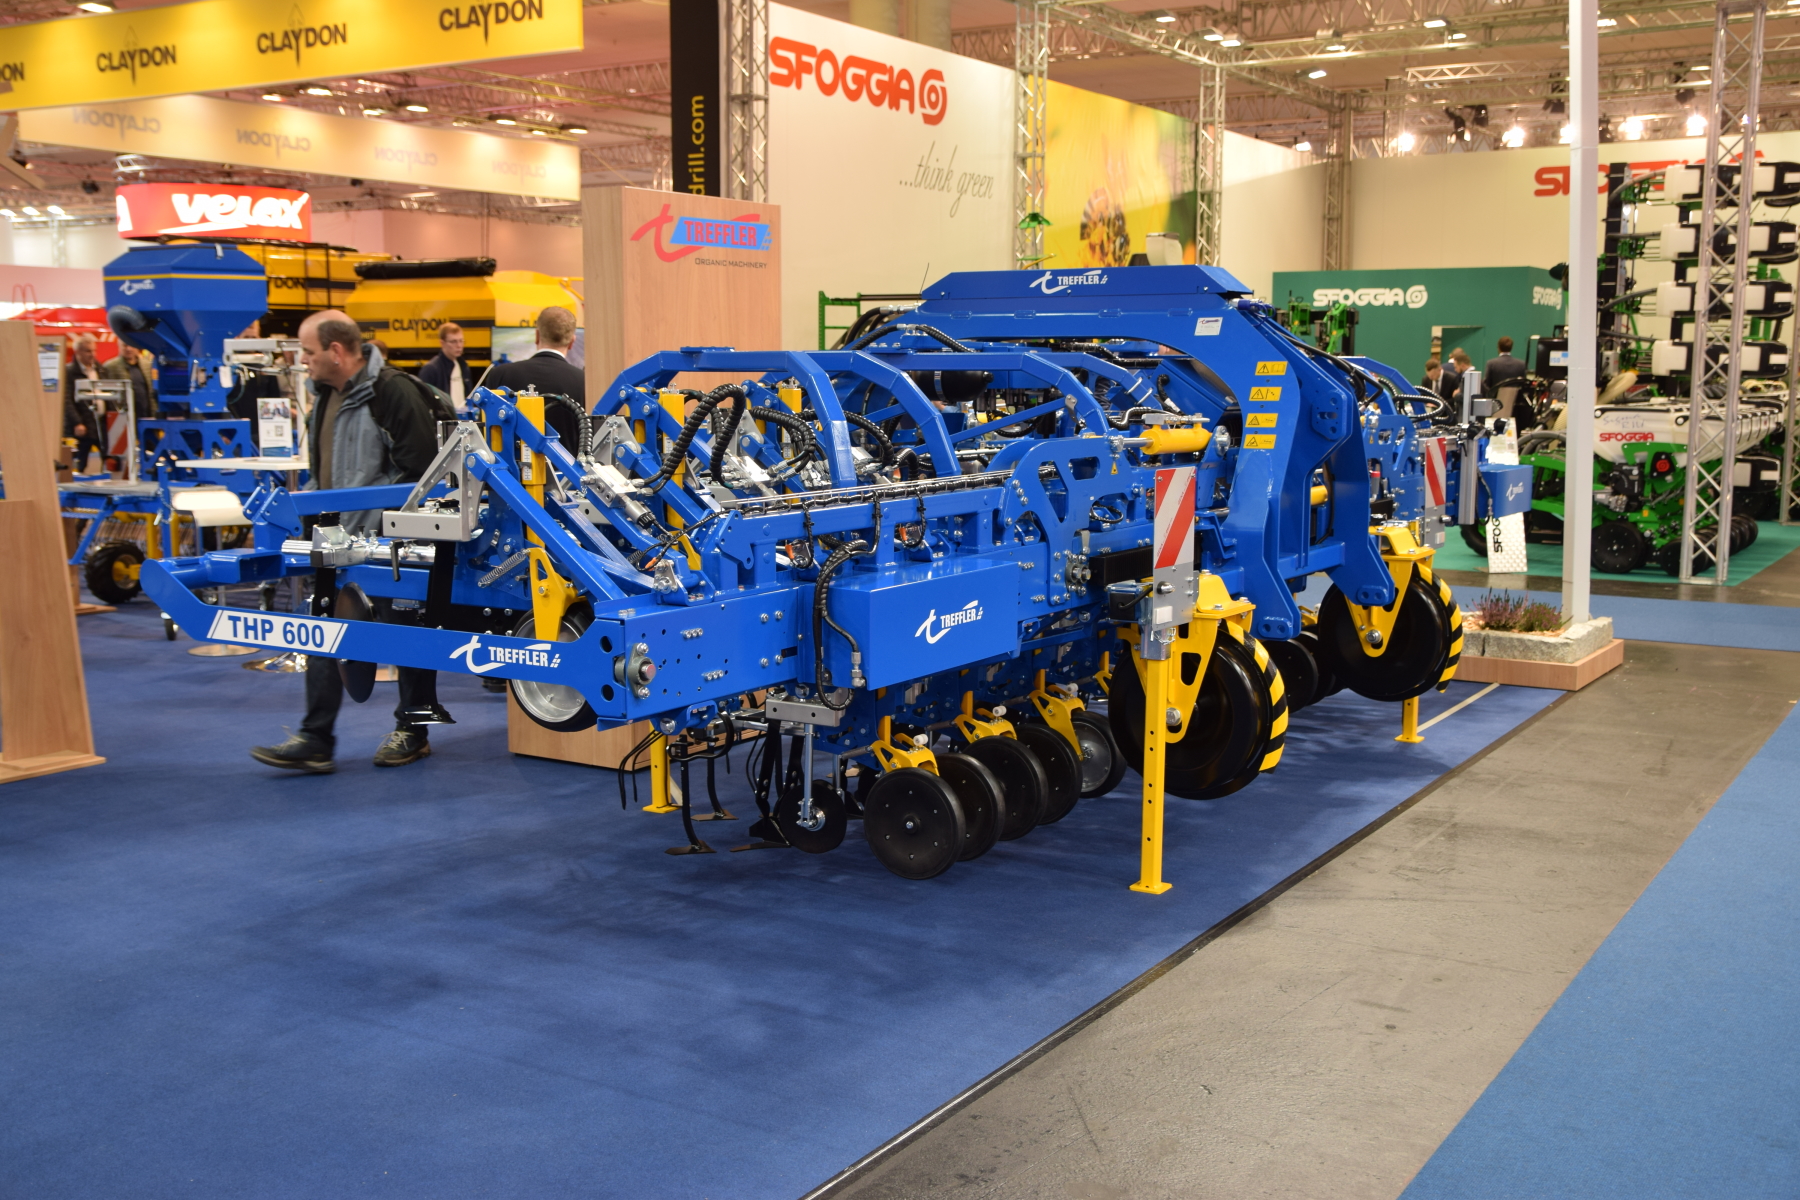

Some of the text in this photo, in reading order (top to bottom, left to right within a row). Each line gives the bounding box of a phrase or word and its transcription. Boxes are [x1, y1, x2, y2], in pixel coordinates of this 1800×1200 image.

[439, 0, 544, 46] CLAYDON
[257, 23, 347, 67] CLAYDON
[0, 61, 26, 82] ON
[96, 44, 177, 86] CLAYDON
[768, 36, 916, 115] SFOGGIA
[949, 170, 995, 219] green
[683, 220, 758, 247] TREFFLER
[728, 260, 768, 270] MACHINERY
[1057, 274, 1100, 286] TREFFLER
[1312, 287, 1405, 307] SFOGGIA
[1599, 431, 1655, 442] SFOGGIA
[940, 608, 977, 629] TREFFLER
[227, 614, 325, 649] THP 600
[488, 646, 549, 668] TREFFLER
